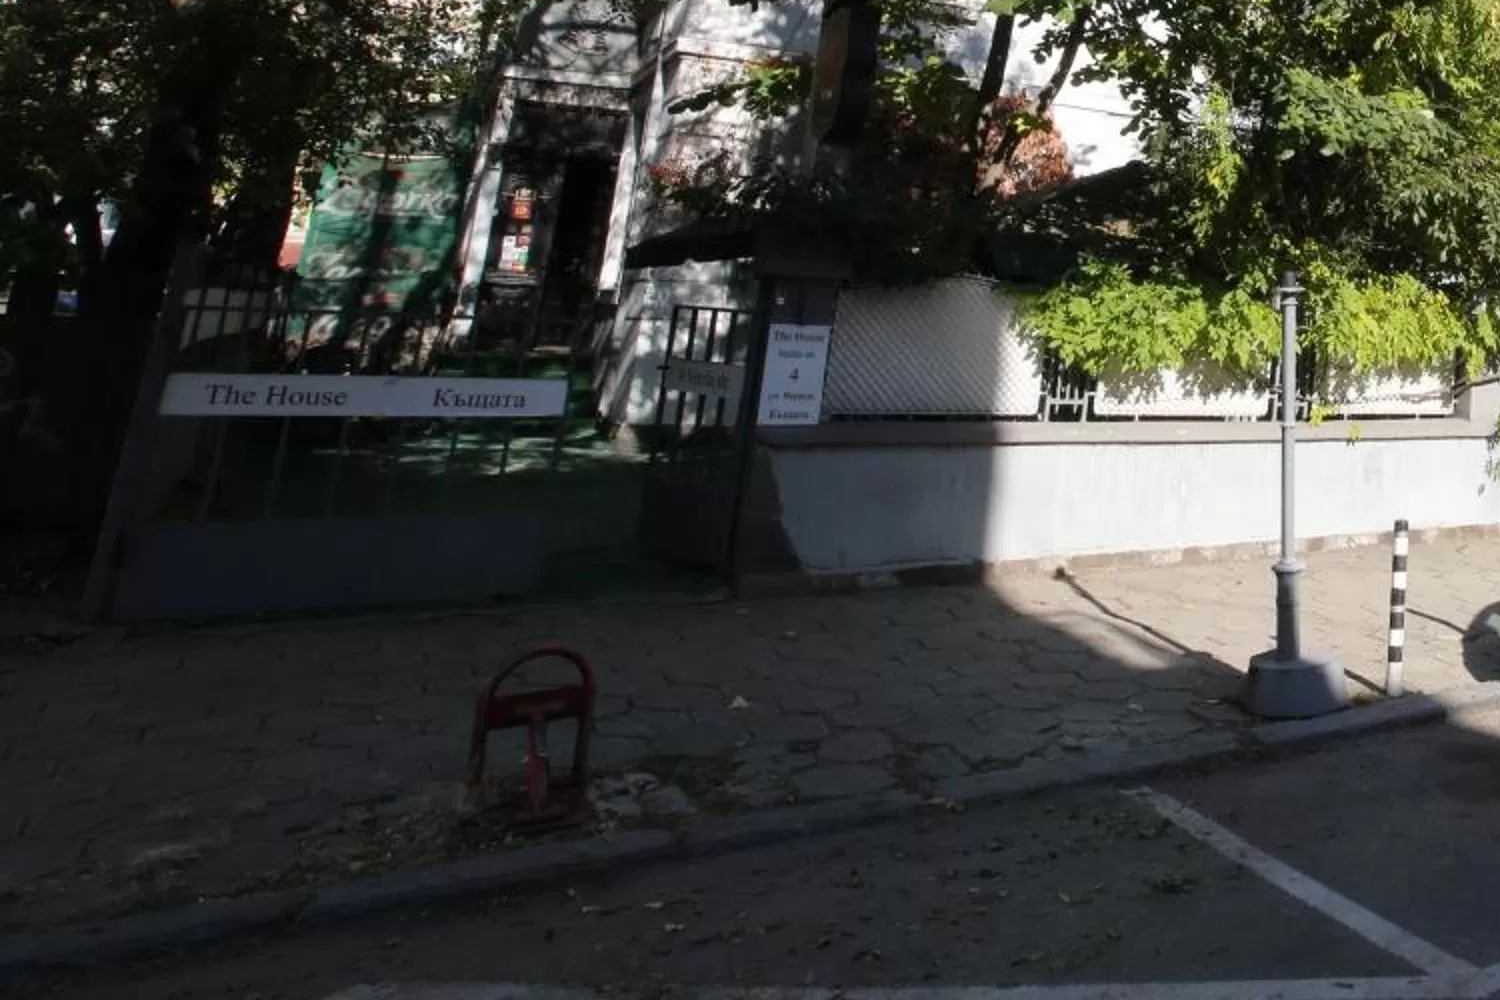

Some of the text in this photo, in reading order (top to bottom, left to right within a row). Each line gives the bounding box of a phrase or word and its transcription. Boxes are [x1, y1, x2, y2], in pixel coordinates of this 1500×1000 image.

[788, 368, 800, 381] 4
[206, 384, 348, 407] The House
[433, 387, 525, 409] Къщата
